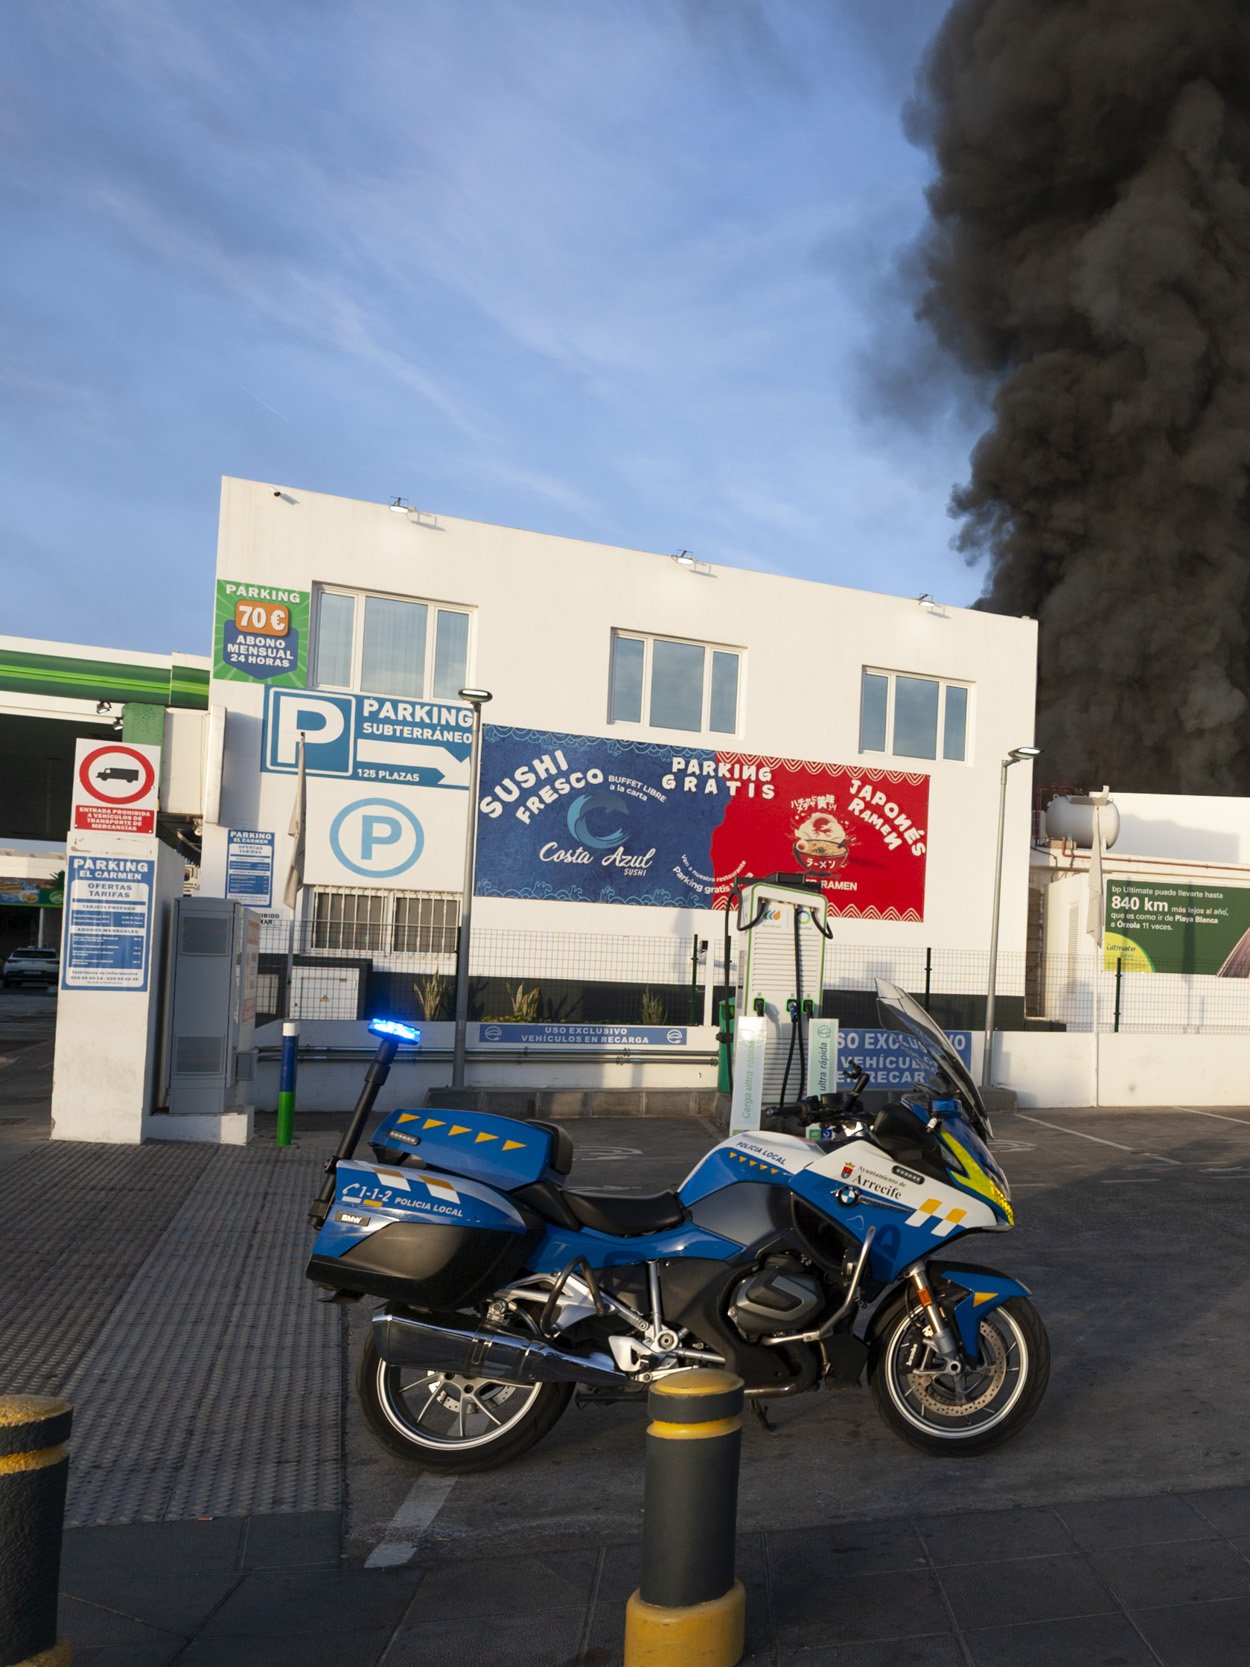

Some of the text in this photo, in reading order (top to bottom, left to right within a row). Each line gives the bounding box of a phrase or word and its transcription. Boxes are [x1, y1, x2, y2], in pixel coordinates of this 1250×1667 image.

[226, 584, 300, 604] PARKING
[239, 605, 286, 631] 70 €
[236, 635, 286, 648] ABONO
[227, 644, 294, 660] MENSUAL
[230, 654, 290, 668] 24 HORAS
[362, 699, 473, 728] PARKING
[277, 697, 345, 764] P
[362, 722, 473, 744] SUBTERRÁNEO
[357, 768, 420, 783] 125 PLAZAS
[672, 757, 773, 782] PARKING
[479, 750, 569, 818] SUSHI
[608, 774, 667, 803] BUFFET LIBRE
[617, 784, 625, 793] la
[626, 787, 648, 802] carta
[661, 775, 775, 800] GRATIS
[515, 768, 604, 825] FRESCO
[80, 806, 150, 817] ENTRADA PROHIBIDA
[87, 818, 132, 826] TRANSPORTE
[848, 798, 902, 851] RAMEN
[230, 831, 272, 840] PARKING
[361, 814, 402, 860] P
[539, 842, 656, 870] Costa Azul
[806, 858, 836, 869] ラーメン
[73, 858, 148, 873] PARKING
[624, 868, 647, 877] SUSHI
[692, 870, 716, 882] nuestro
[716, 860, 746, 882] restaurante
[80, 870, 142, 880] EL CARMEN
[672, 866, 731, 894] Parking gratis
[88, 882, 132, 890] OFERTAS
[89, 890, 130, 898] TARIFAS
[821, 880, 858, 891] RAMEN
[1123, 887, 1154, 895] Ultimate
[1178, 890, 1203, 898] llevarte
[1111, 896, 1140, 910] 840
[1144, 897, 1168, 912] km
[1188, 906, 1204, 915] lejos
[1117, 920, 1140, 928] Órzola
[1175, 915, 1194, 923] Playa
[1195, 916, 1218, 924] Blanca
[521, 1034, 582, 1043] VEHÍCULOS
[600, 1036, 649, 1044] RECARGA
[569, 1027, 628, 1035] EXCLUSIVO
[818, 1042, 829, 1091] ultra rápida
[736, 1140, 786, 1166] POLICIA LOCAL
[858, 1165, 898, 1185] Ayuntamiento
[358, 1186, 392, 1201] 1-1-2
[852, 1174, 902, 1200] Arrecife
[394, 1196, 463, 1217] POLICIA LOCAL
[340, 1213, 362, 1224] BMW
